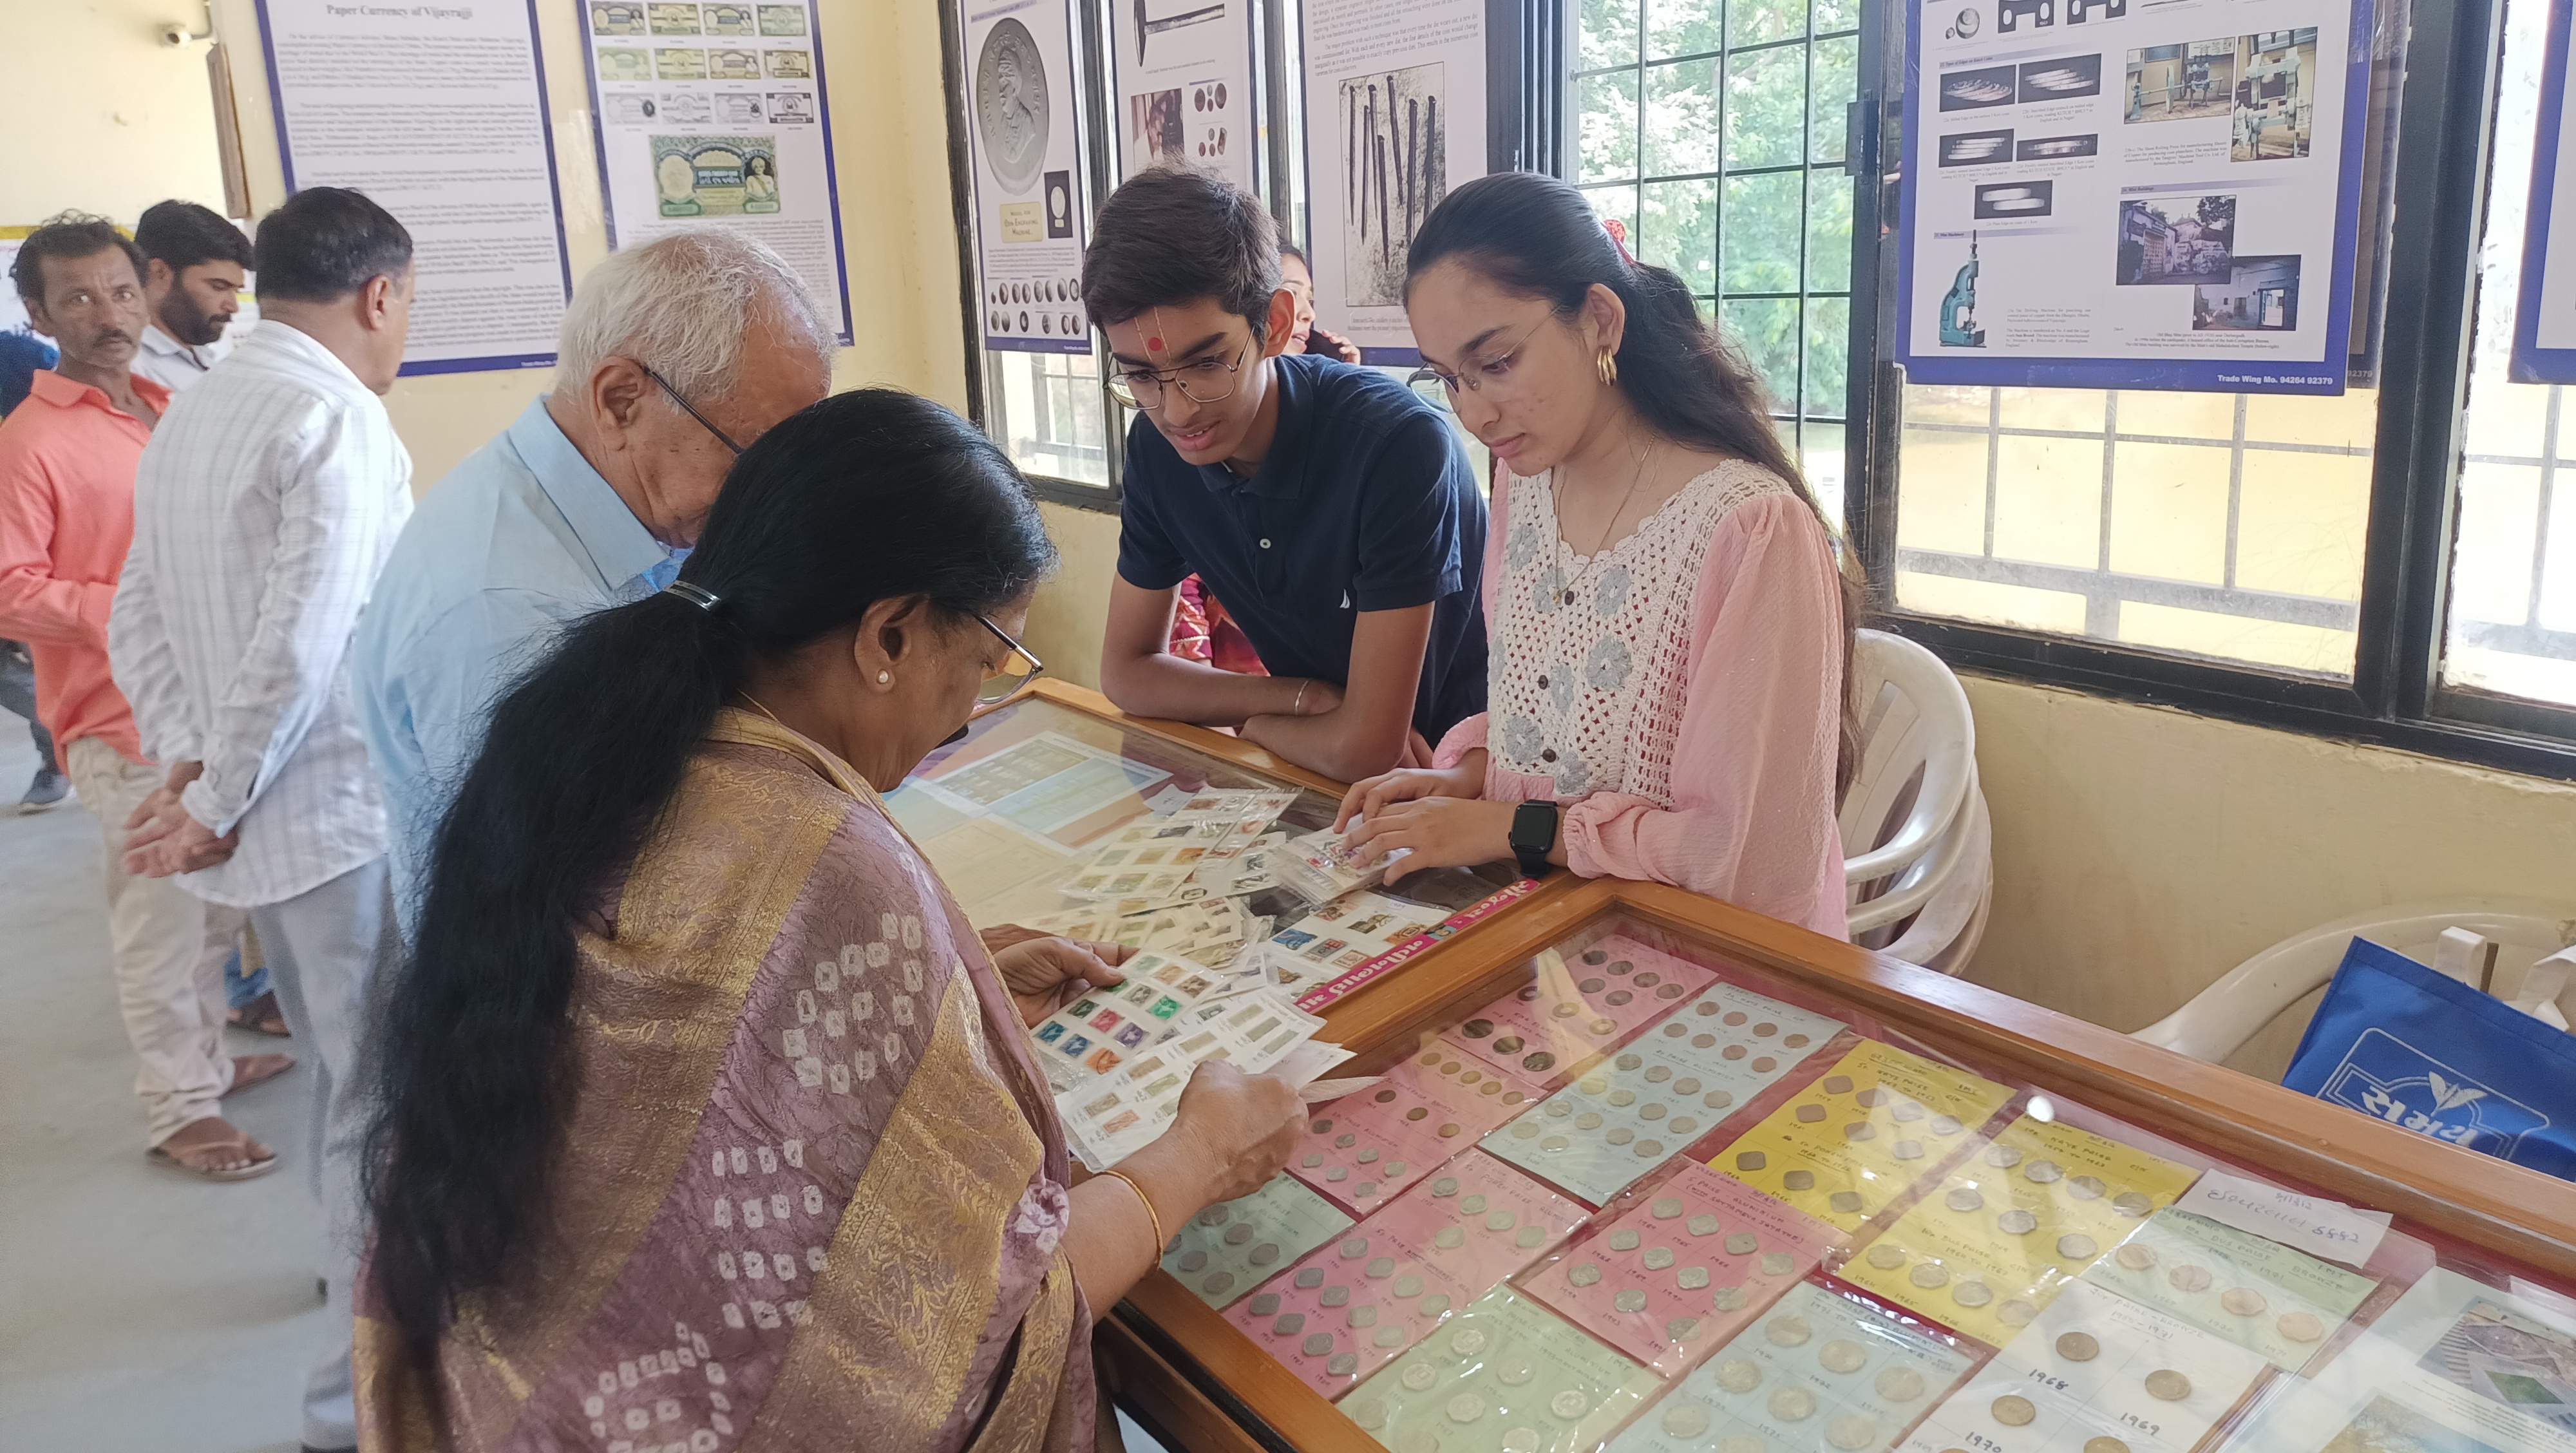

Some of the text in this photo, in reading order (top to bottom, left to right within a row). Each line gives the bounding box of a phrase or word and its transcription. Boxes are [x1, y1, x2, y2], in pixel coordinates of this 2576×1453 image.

[327, 5, 357, 17] Paper
[360, 5, 408, 18] Currency
[412, 7, 422, 16] of
[2242, 375, 2262, 383] Wing
[1328, 938, 1425, 998] નવીનભાઈ
[1697, 1180, 1721, 1195] PAISE
[2114, 1298, 2148, 1318] PAISE
[1602, 1312, 1622, 1327] 1993
[1607, 1355, 1633, 1372] IMT
[2028, 1369, 2161, 1437] 1968 1969
[1964, 1431, 2003, 1453] 1970
